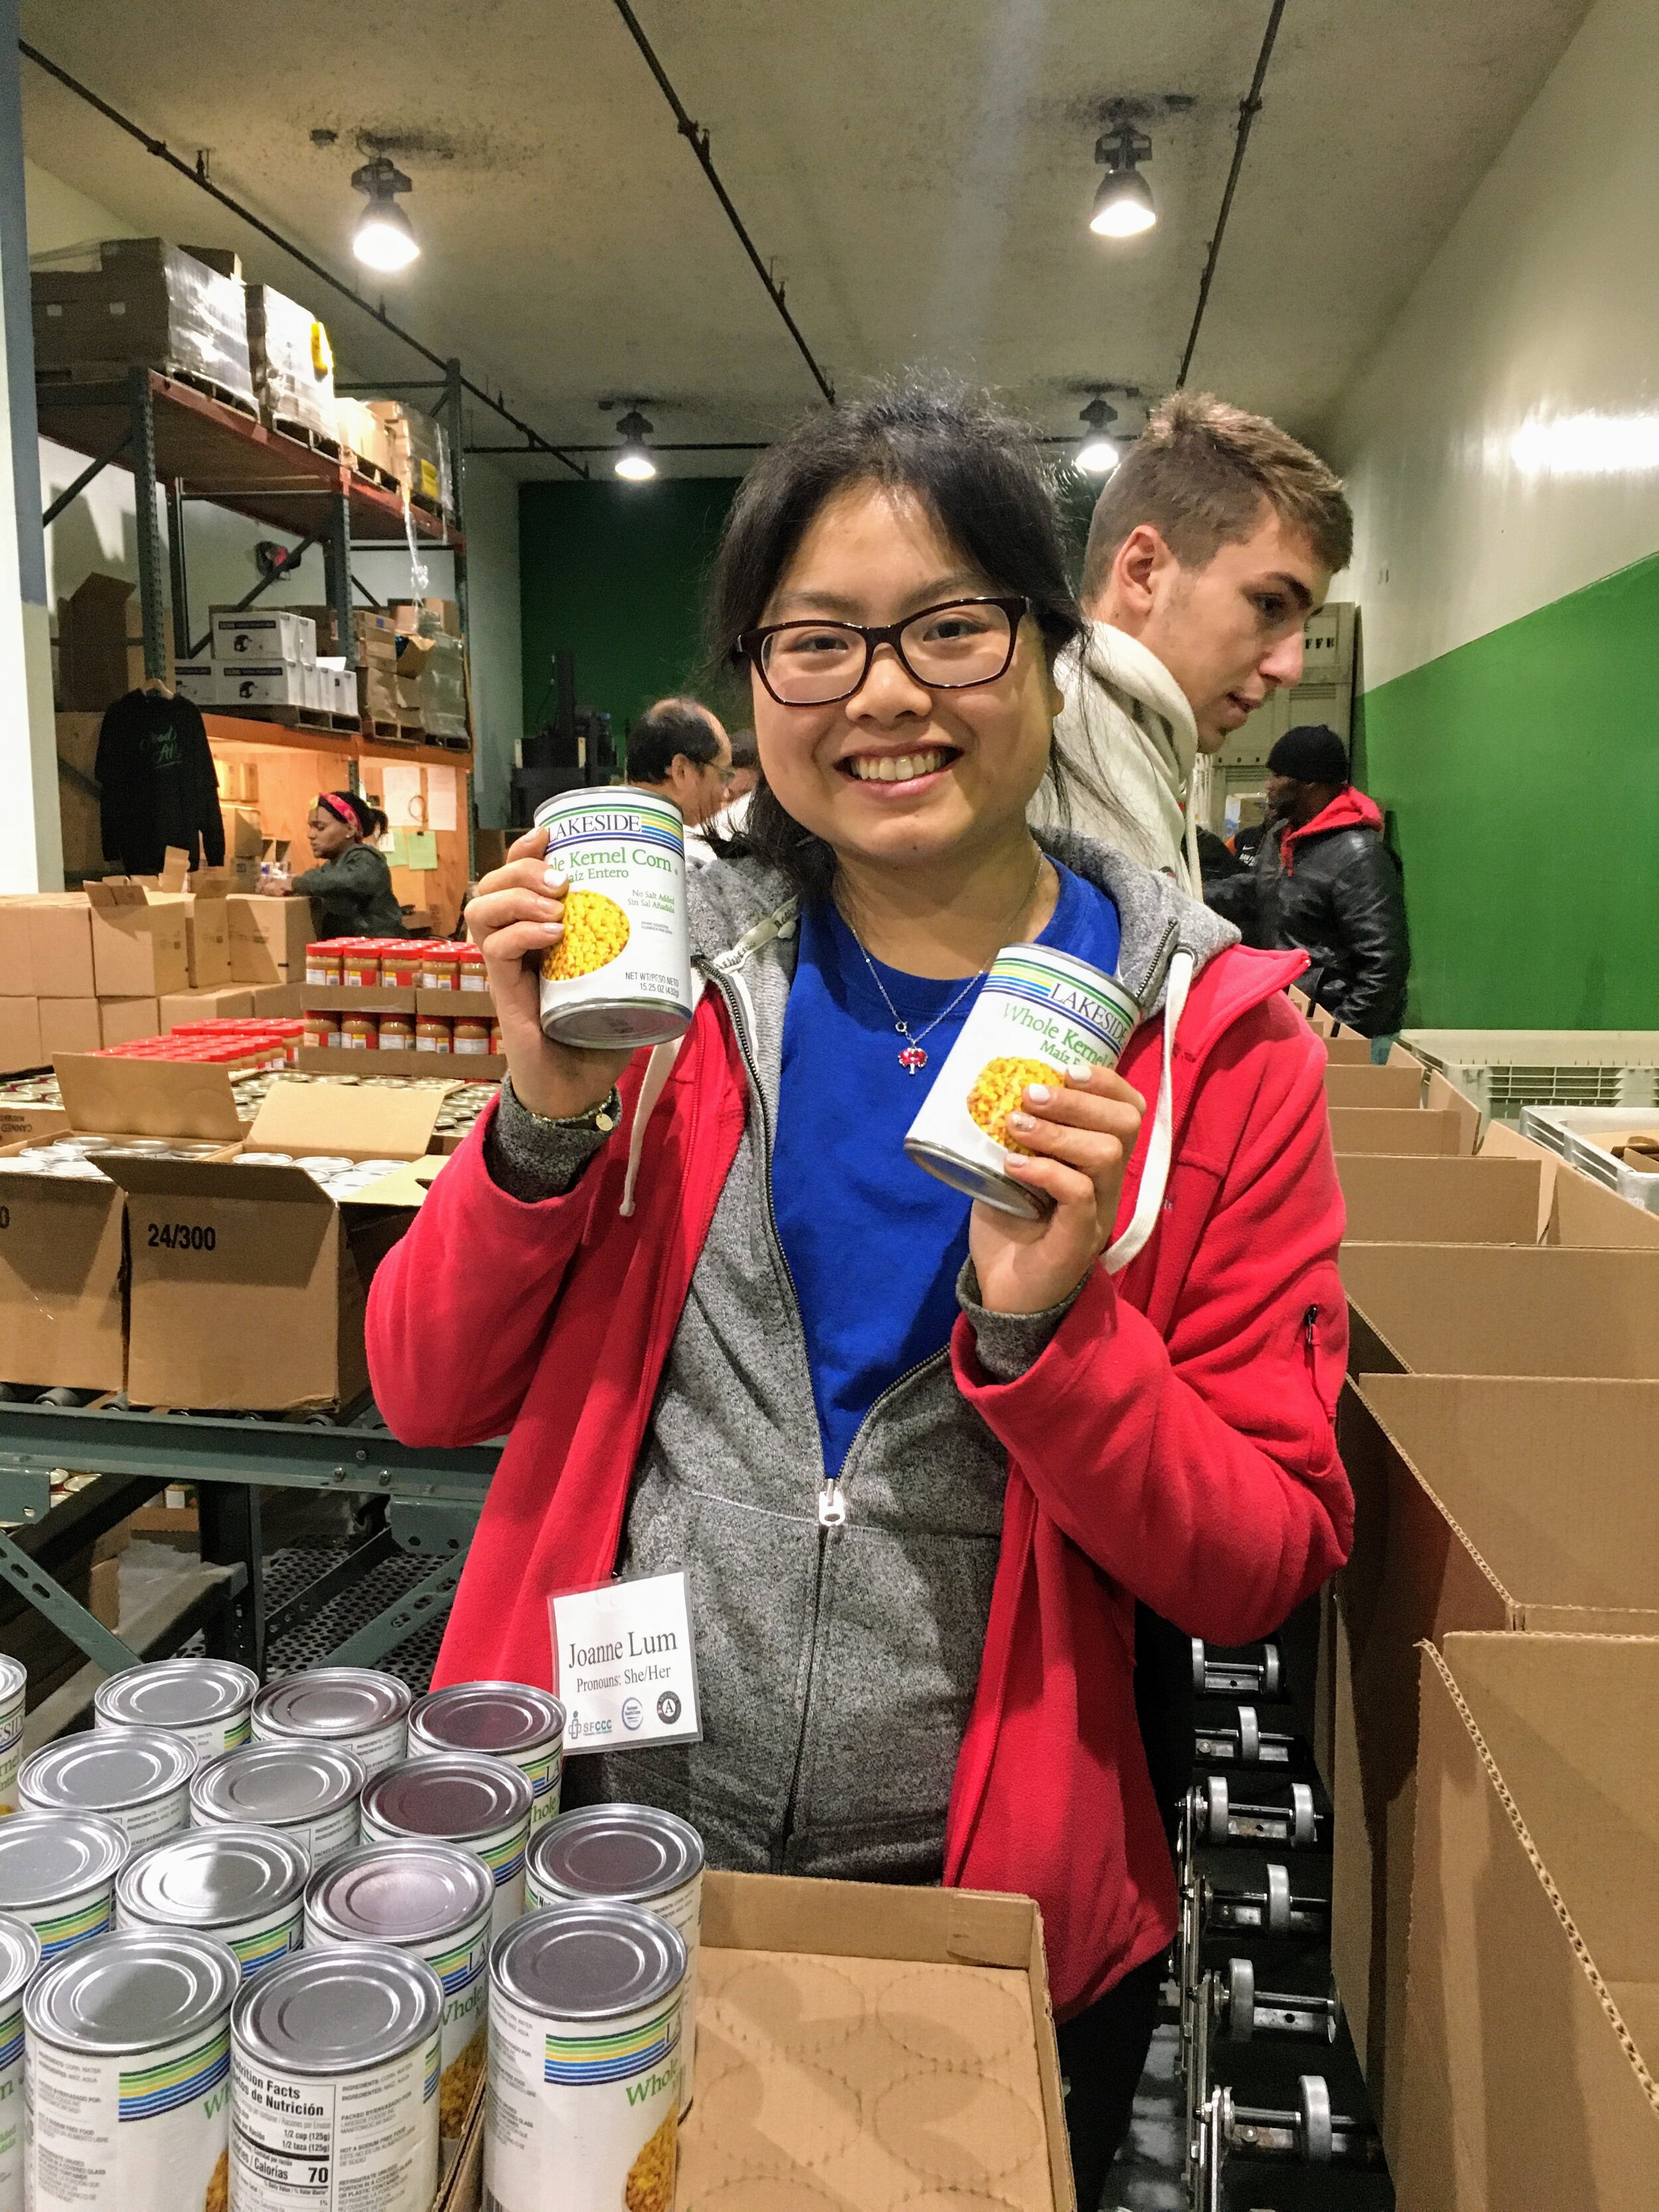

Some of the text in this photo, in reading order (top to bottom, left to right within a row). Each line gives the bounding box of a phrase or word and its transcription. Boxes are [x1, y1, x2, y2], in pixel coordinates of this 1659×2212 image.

[549, 814, 641, 842] LAKESIDE
[569, 848, 626, 868] Kernel
[632, 849, 672, 873] Corn
[568, 868, 629, 883] aíz Entero
[645, 891, 657, 899] Salt
[625, 972, 638, 980] NET
[667, 976, 679, 988] NETO
[657, 984, 665, 993] OZ
[1050, 982, 1129, 1046] LAKESIDE
[1003, 1003, 1108, 1065] Whole Kernel
[1039, 1040, 1070, 1065] Maíz
[148, 1223, 216, 1250] 24/300
[569, 1631, 678, 1668] Joanne Lum
[576, 1664, 671, 1692] Pronouns: She/Her
[583, 1720, 613, 1733] SFCCC
[531, 1796, 556, 1822] hole
[267, 2080, 300, 2099] Facts
[252, 2089, 263, 2104] de
[266, 2095, 324, 2116] Nutrición
[341, 2112, 365, 2120] PACKED
[284, 2129, 330, 2142] 1/2 cup (125g)
[293, 2142, 307, 2151] taza
[309, 2142, 330, 2153] (125g)
[254, 2157, 289, 2180] Calorías
[308, 2167, 329, 2183] 70
